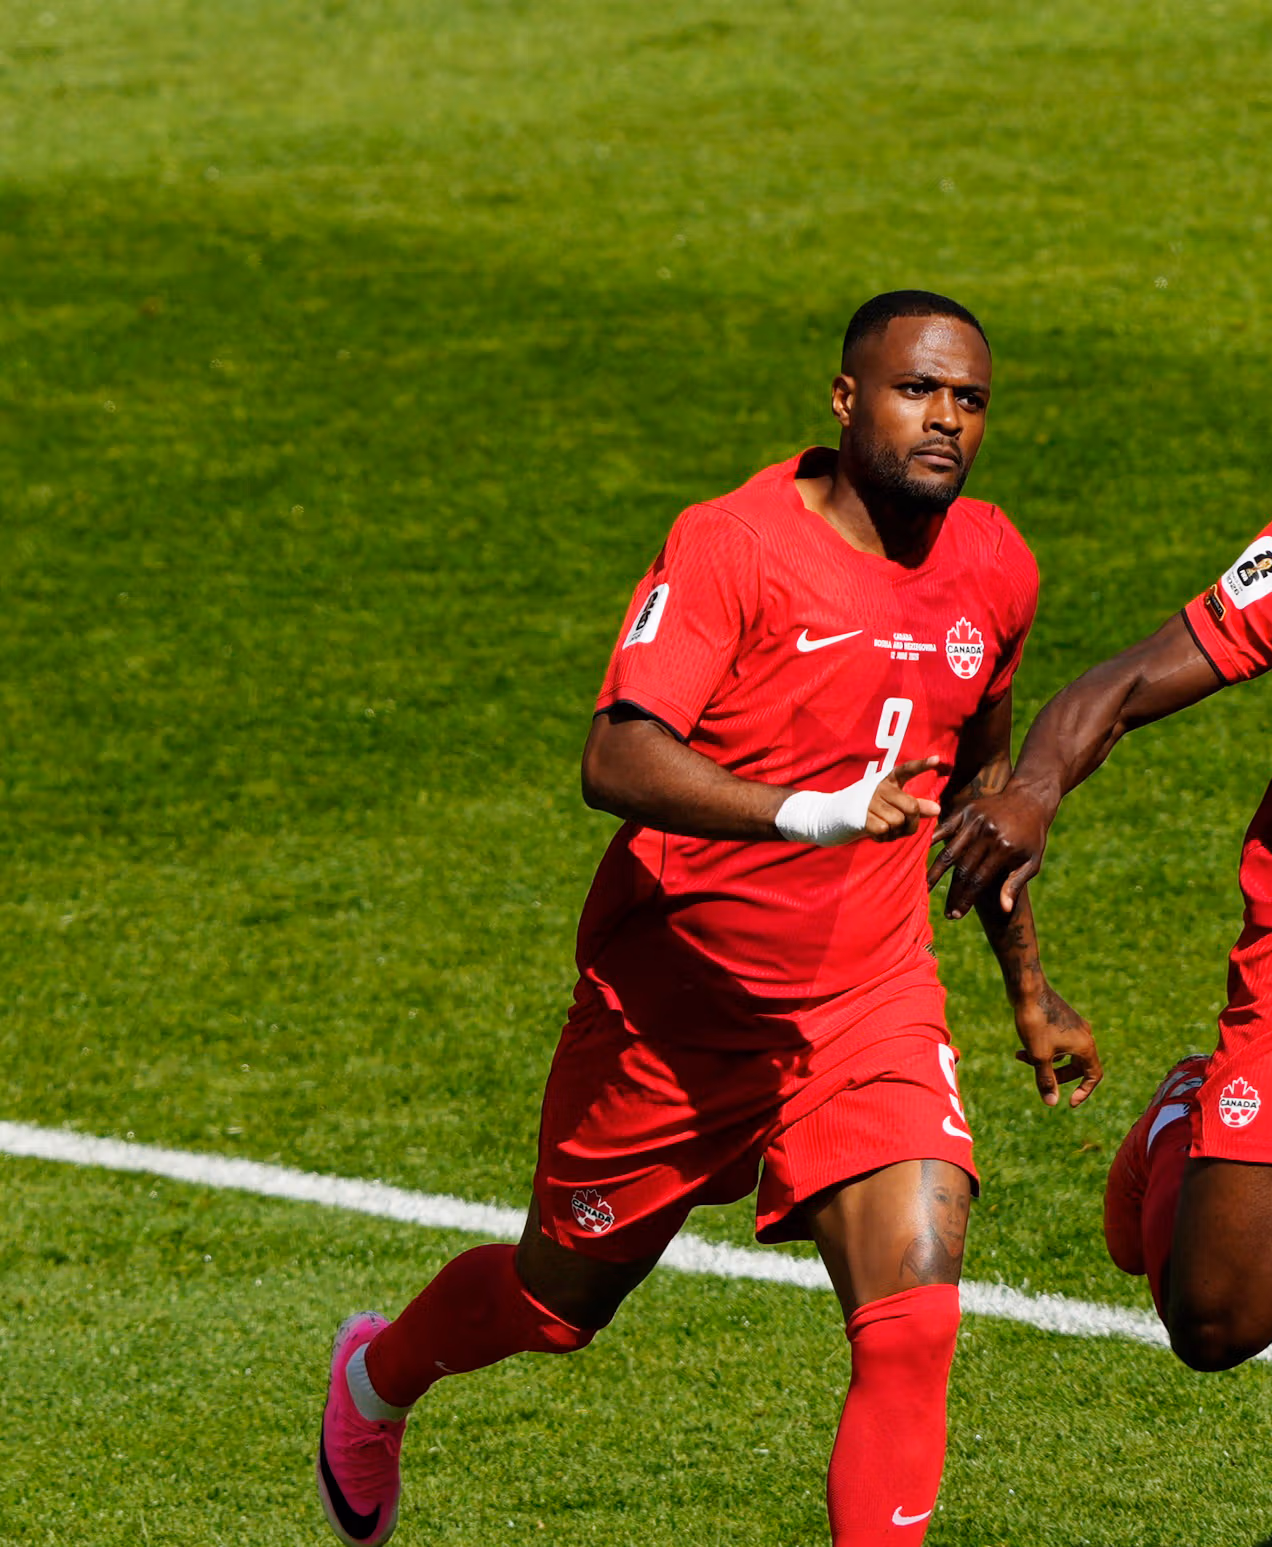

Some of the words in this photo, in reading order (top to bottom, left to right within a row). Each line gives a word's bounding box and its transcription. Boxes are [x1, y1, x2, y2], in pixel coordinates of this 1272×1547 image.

[947, 645, 982, 655] CANADA
[862, 697, 914, 781] 9
[1220, 1099, 1257, 1109] CANADA
[572, 1199, 612, 1222] CANADA
